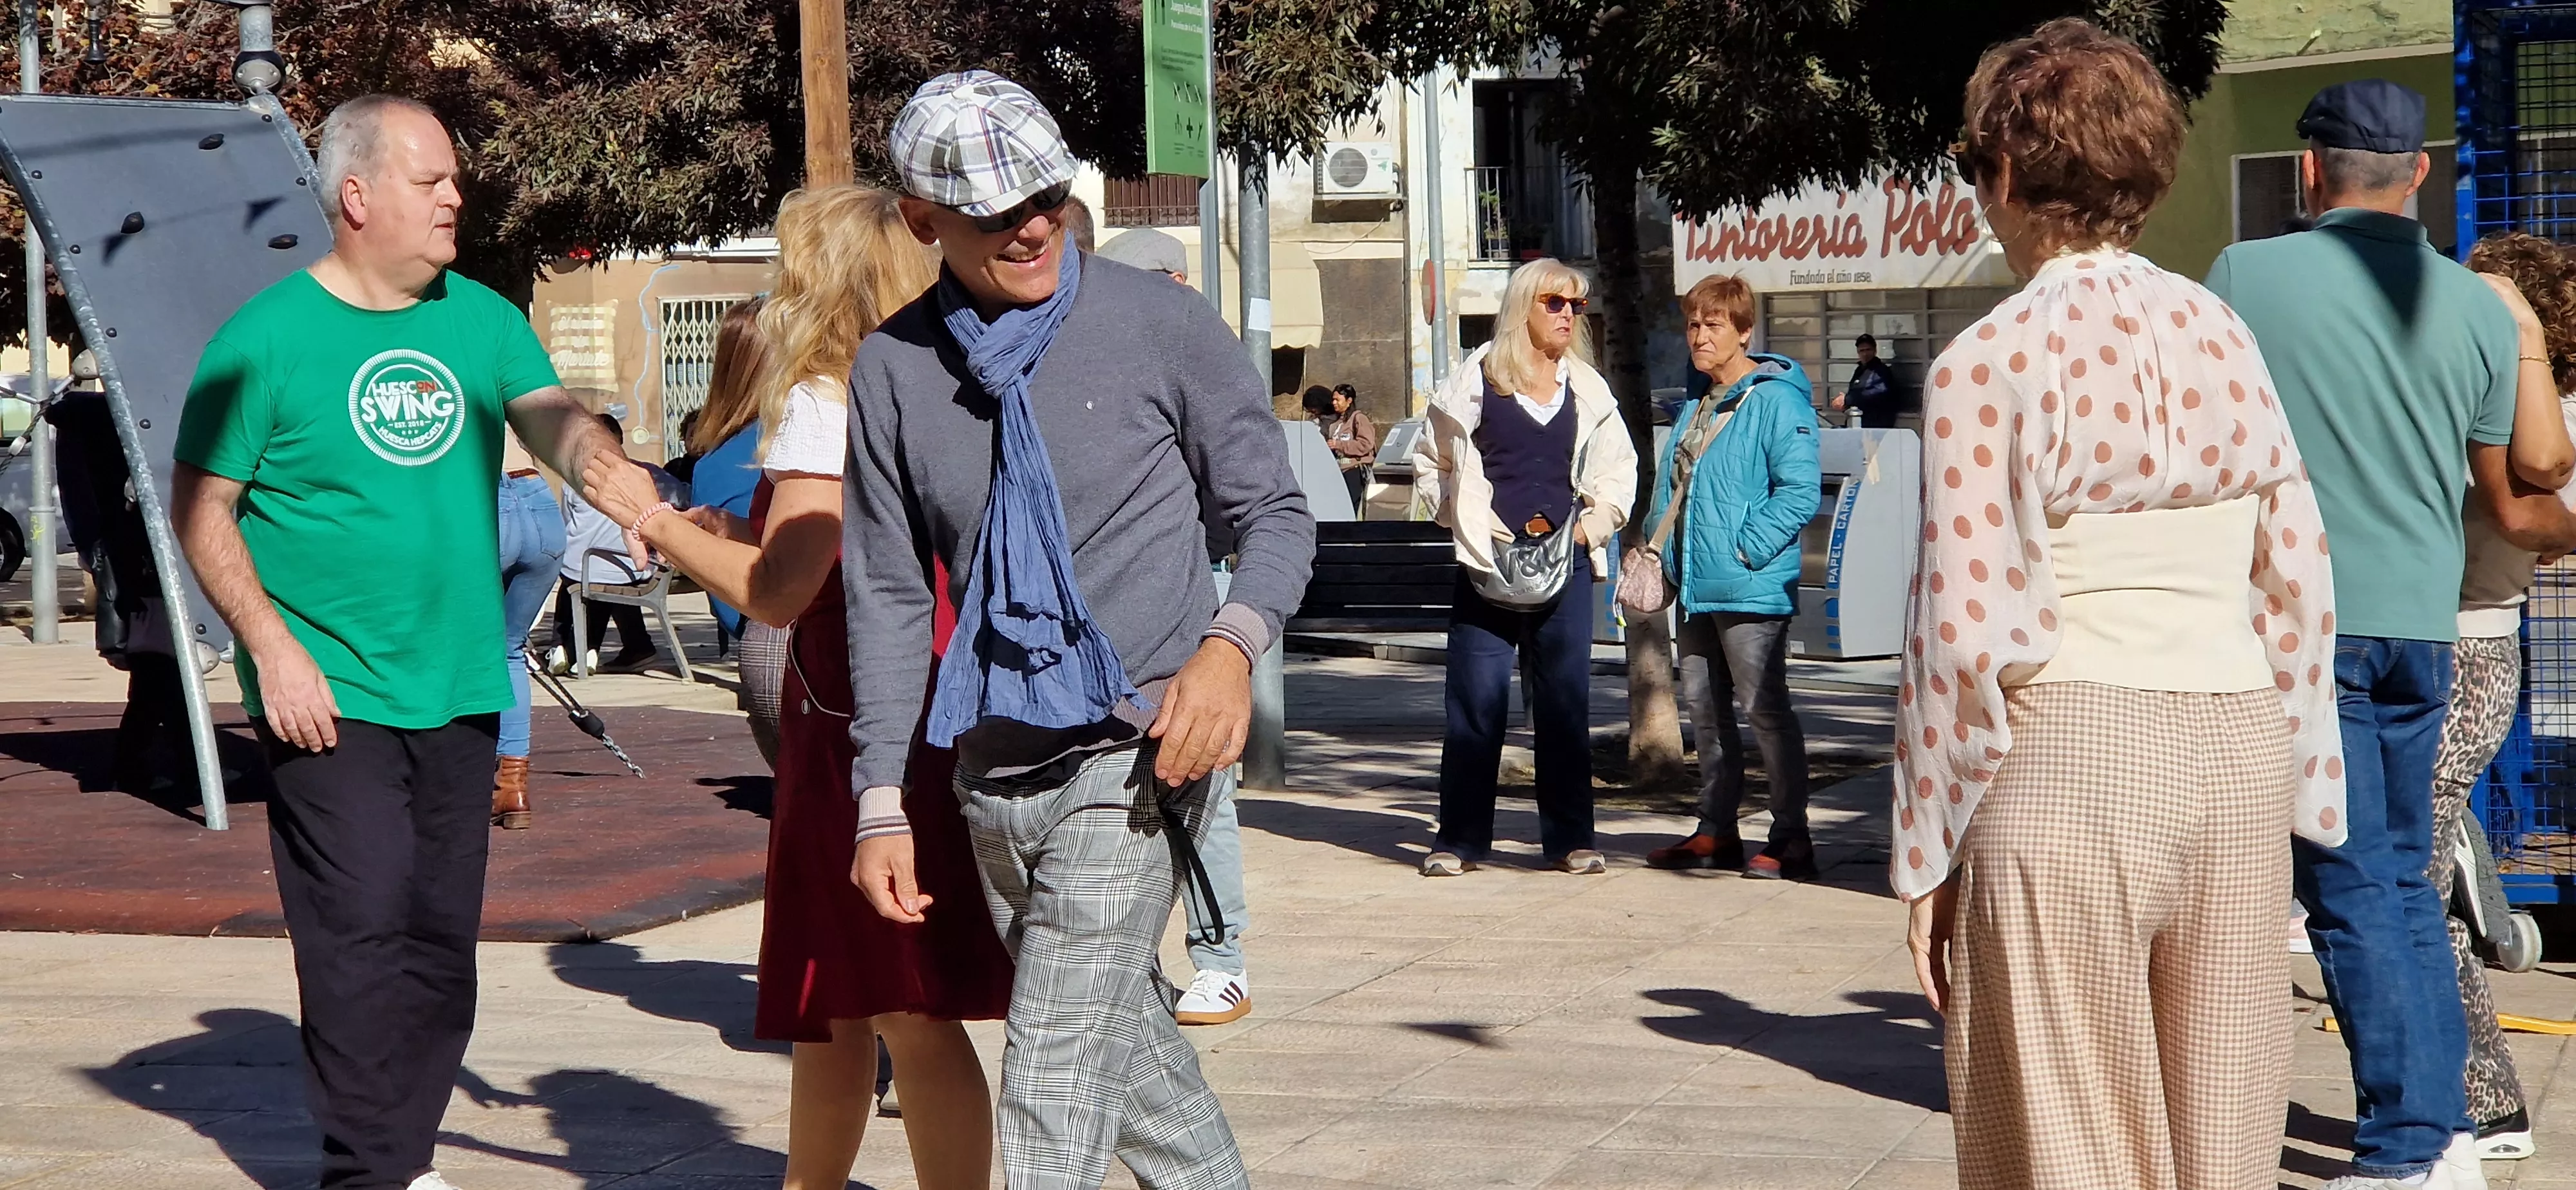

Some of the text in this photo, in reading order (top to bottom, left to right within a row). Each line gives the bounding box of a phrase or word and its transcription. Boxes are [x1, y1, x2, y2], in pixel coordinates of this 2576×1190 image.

[1880, 175, 1980, 258] Polo
[1790, 269, 1825, 285] Fundado
[1827, 269, 1835, 283] el
[1836, 269, 1852, 283] año
[360, 390, 455, 422] SWING
[378, 421, 442, 446] HUESCA HEPCATS
[1828, 542, 1842, 583] PAPEL
